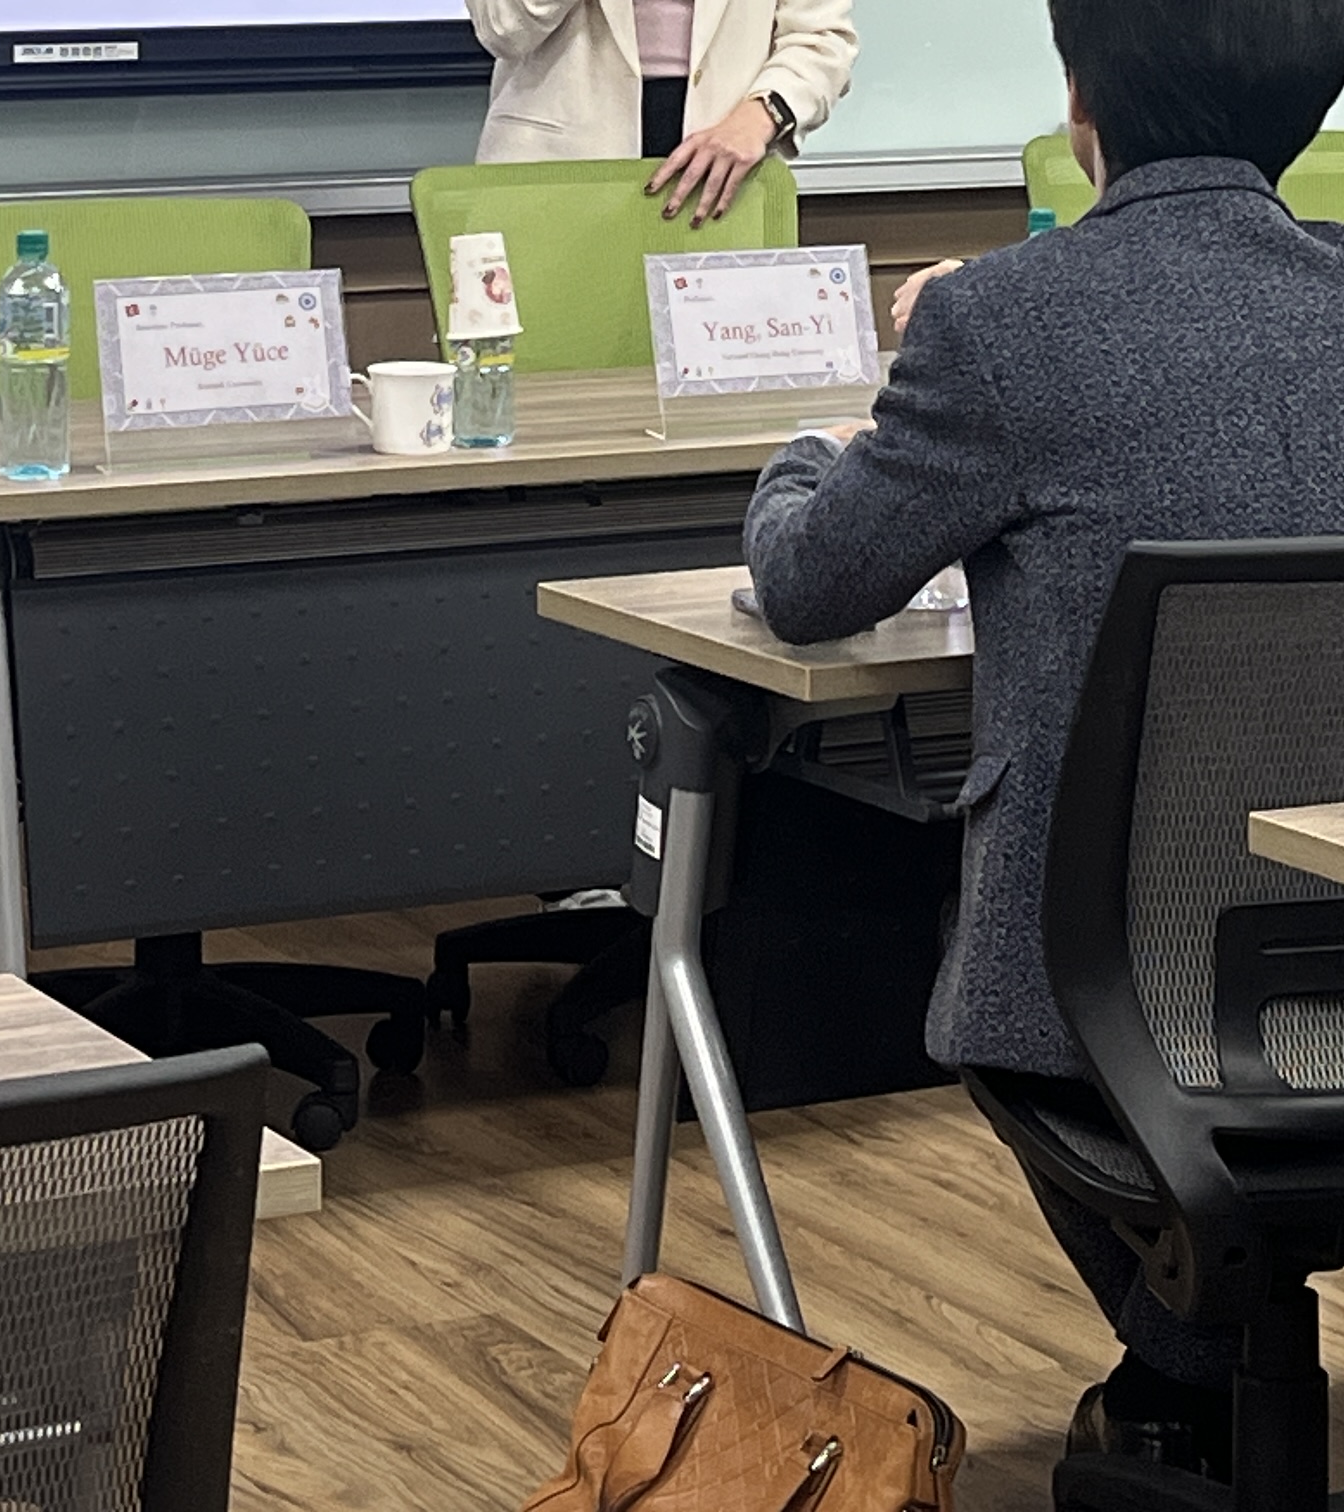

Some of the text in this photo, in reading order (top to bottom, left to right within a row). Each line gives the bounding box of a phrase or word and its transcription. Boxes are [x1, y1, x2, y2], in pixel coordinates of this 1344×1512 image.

[702, 313, 834, 345] Yang, San-Yi
[163, 342, 289, 371] Müge Yüce
